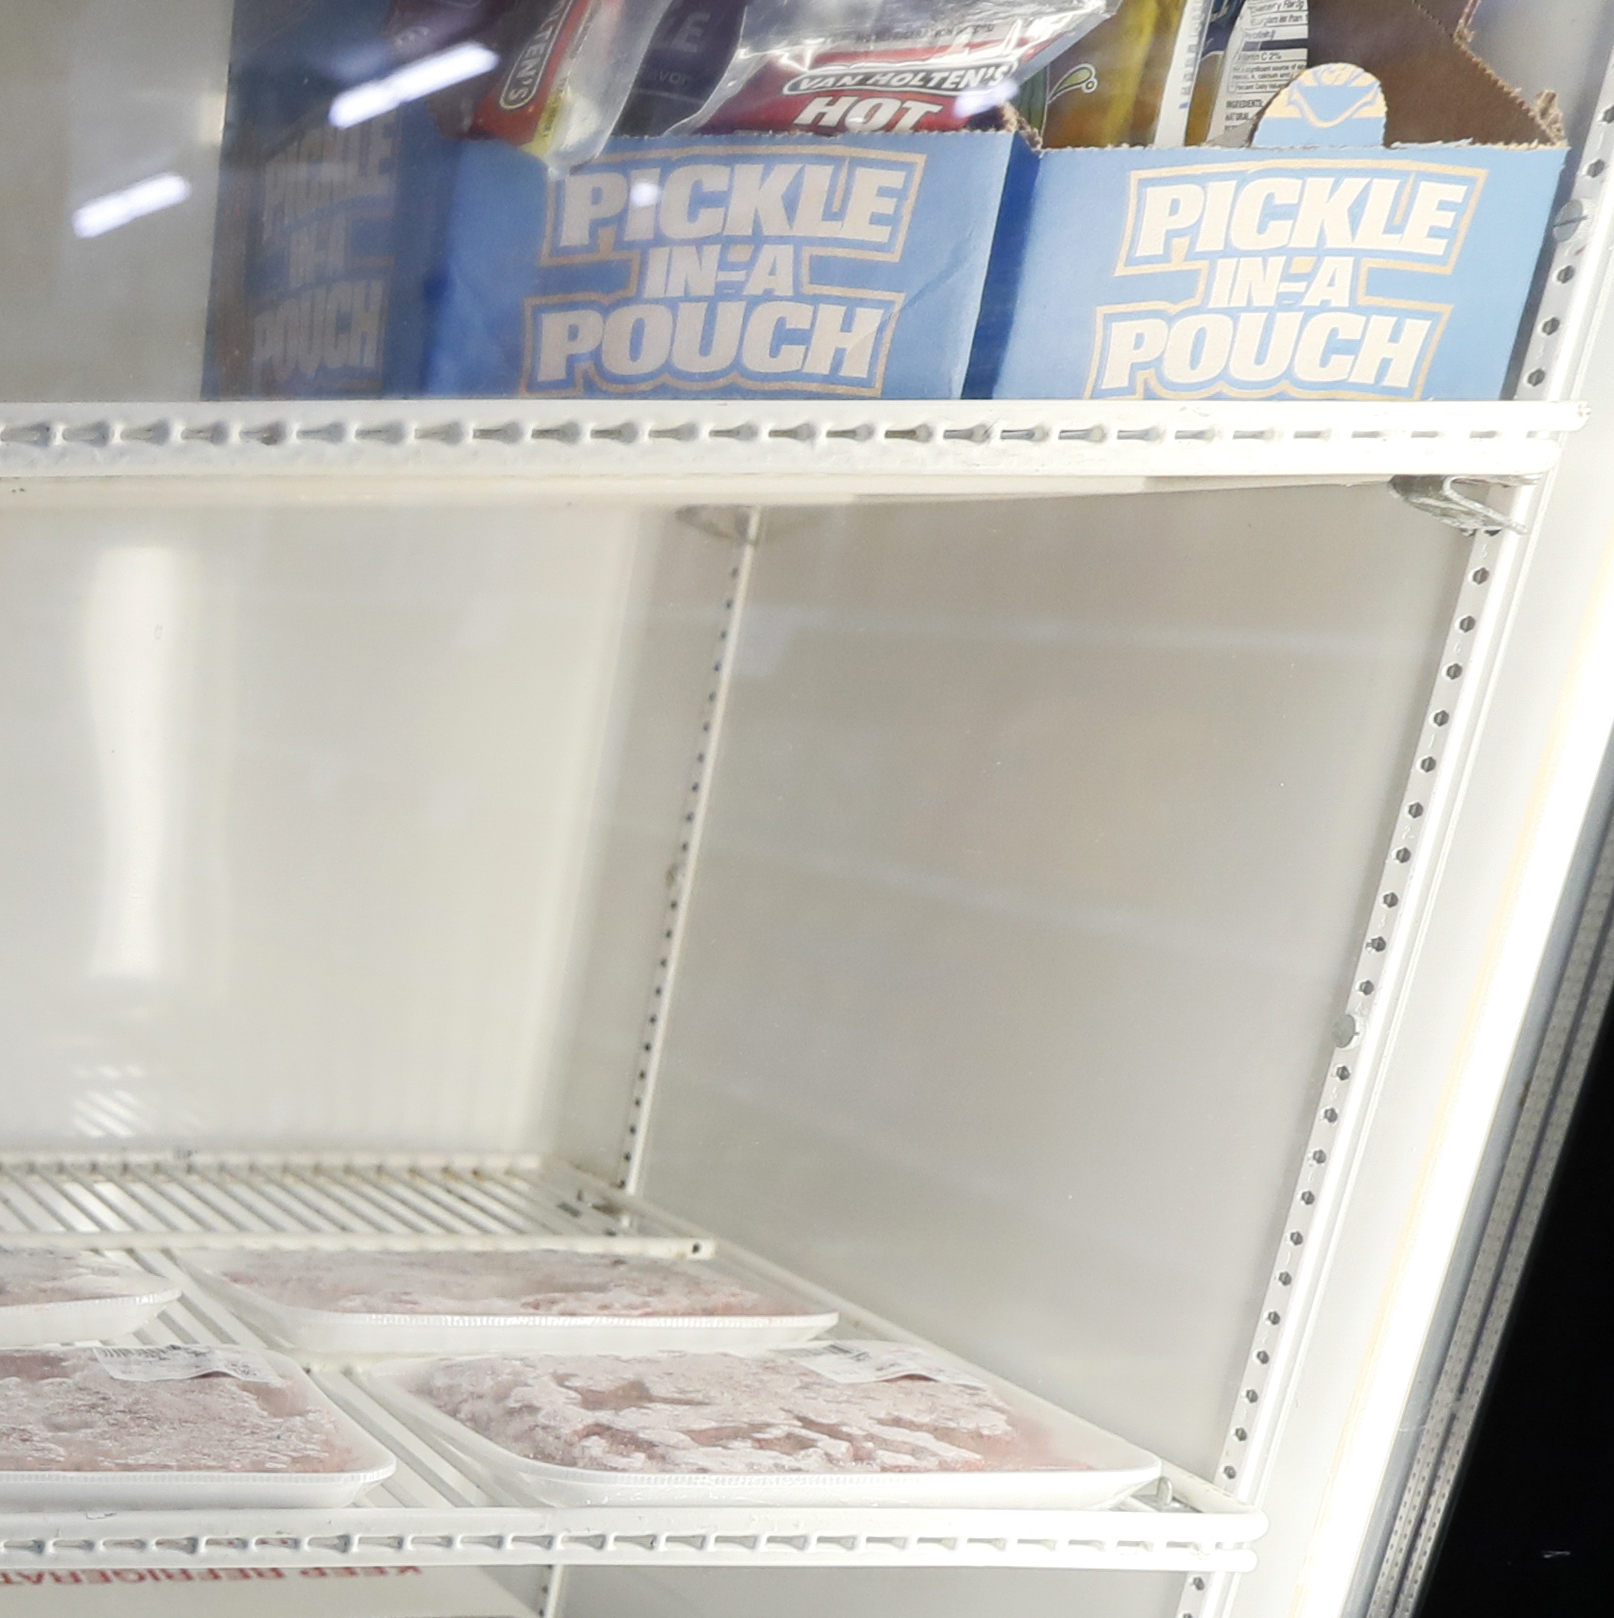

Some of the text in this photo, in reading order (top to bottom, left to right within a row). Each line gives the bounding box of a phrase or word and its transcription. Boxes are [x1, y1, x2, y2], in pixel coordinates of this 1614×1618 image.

[793, 96, 944, 133] HOT
[799, 63, 1011, 91] VAN HOLTEN'S
[558, 163, 909, 249] PICKLE
[1135, 176, 1469, 257] PICKLE
[534, 301, 883, 382] POUCH
[1099, 311, 1432, 391] POUCH
